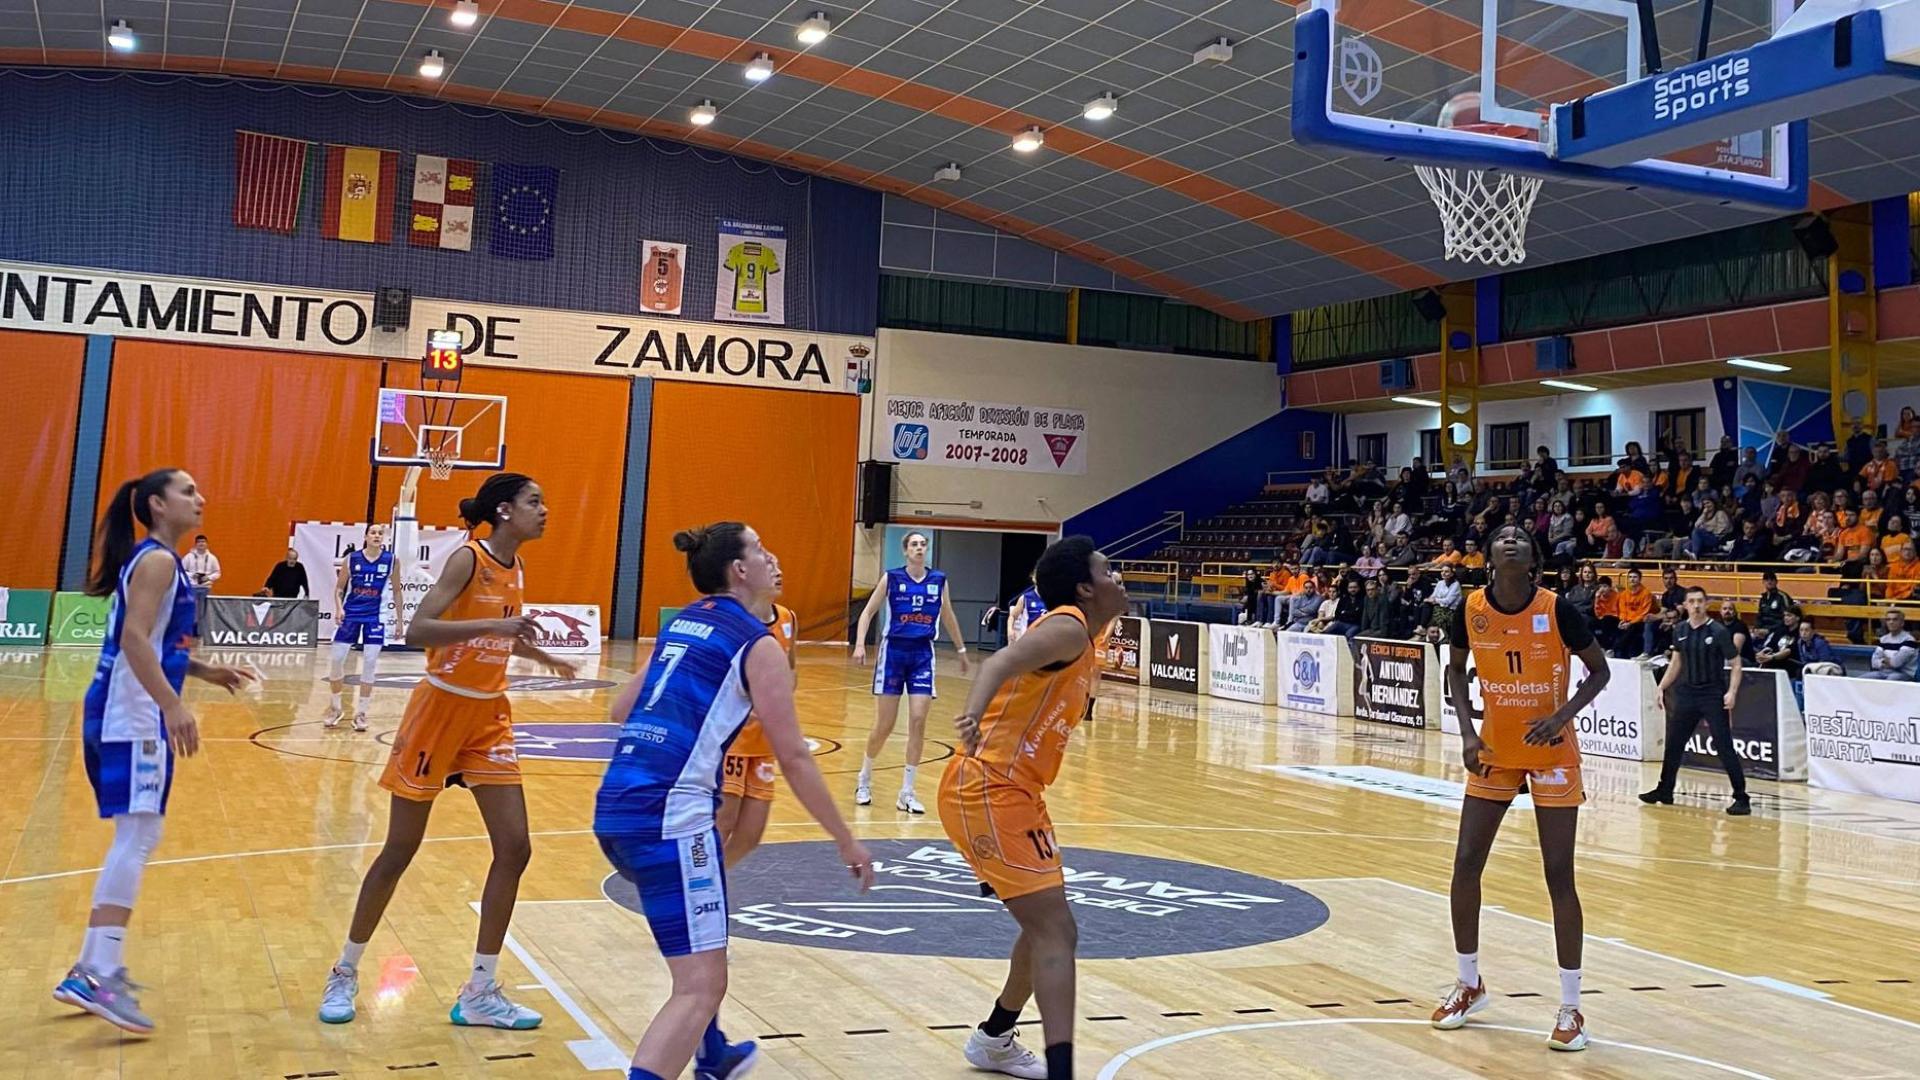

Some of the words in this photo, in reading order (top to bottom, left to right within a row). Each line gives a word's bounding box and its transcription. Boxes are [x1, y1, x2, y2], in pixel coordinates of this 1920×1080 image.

[1654, 58, 1750, 100] Schelde
[1654, 78, 1750, 120] Sports
[657, 257, 669, 276] 5
[747, 262, 756, 279] 9
[0, 271, 367, 346] NTAMIENTO
[446, 312, 520, 359] DE
[594, 325, 831, 384] ZAMORA
[430, 350, 457, 369] 13
[887, 400, 924, 418] MEJOR
[929, 402, 975, 422] AFICIÓN
[979, 406, 1029, 427] DIVISIÓN
[1034, 411, 1048, 428] DE
[1052, 413, 1085, 431] PLATA
[958, 428, 1017, 443] TEMPORADA
[945, 444, 1029, 466] 2007-2008
[363, 573, 375, 583] 11
[911, 595, 924, 606] 13
[210, 630, 309, 645] VALCARCE
[1151, 663, 1196, 682] VALCARCE
[1379, 660, 1413, 682] ANTONIO
[1505, 650, 1522, 674] 11
[644, 641, 689, 711] 7
[1481, 679, 1550, 694] Recoletas
[1371, 683, 1420, 708] HERNÁNDEZ
[1496, 696, 1539, 708] Zamora
[1574, 709, 1638, 740] coletas
[1578, 739, 1639, 756] OSPITALARIA
[1684, 734, 1773, 762] ALCRCE
[1810, 737, 1875, 765] MARTA
[415, 751, 432, 778] 14
[725, 756, 743, 777] 55
[1027, 829, 1053, 860] 13
